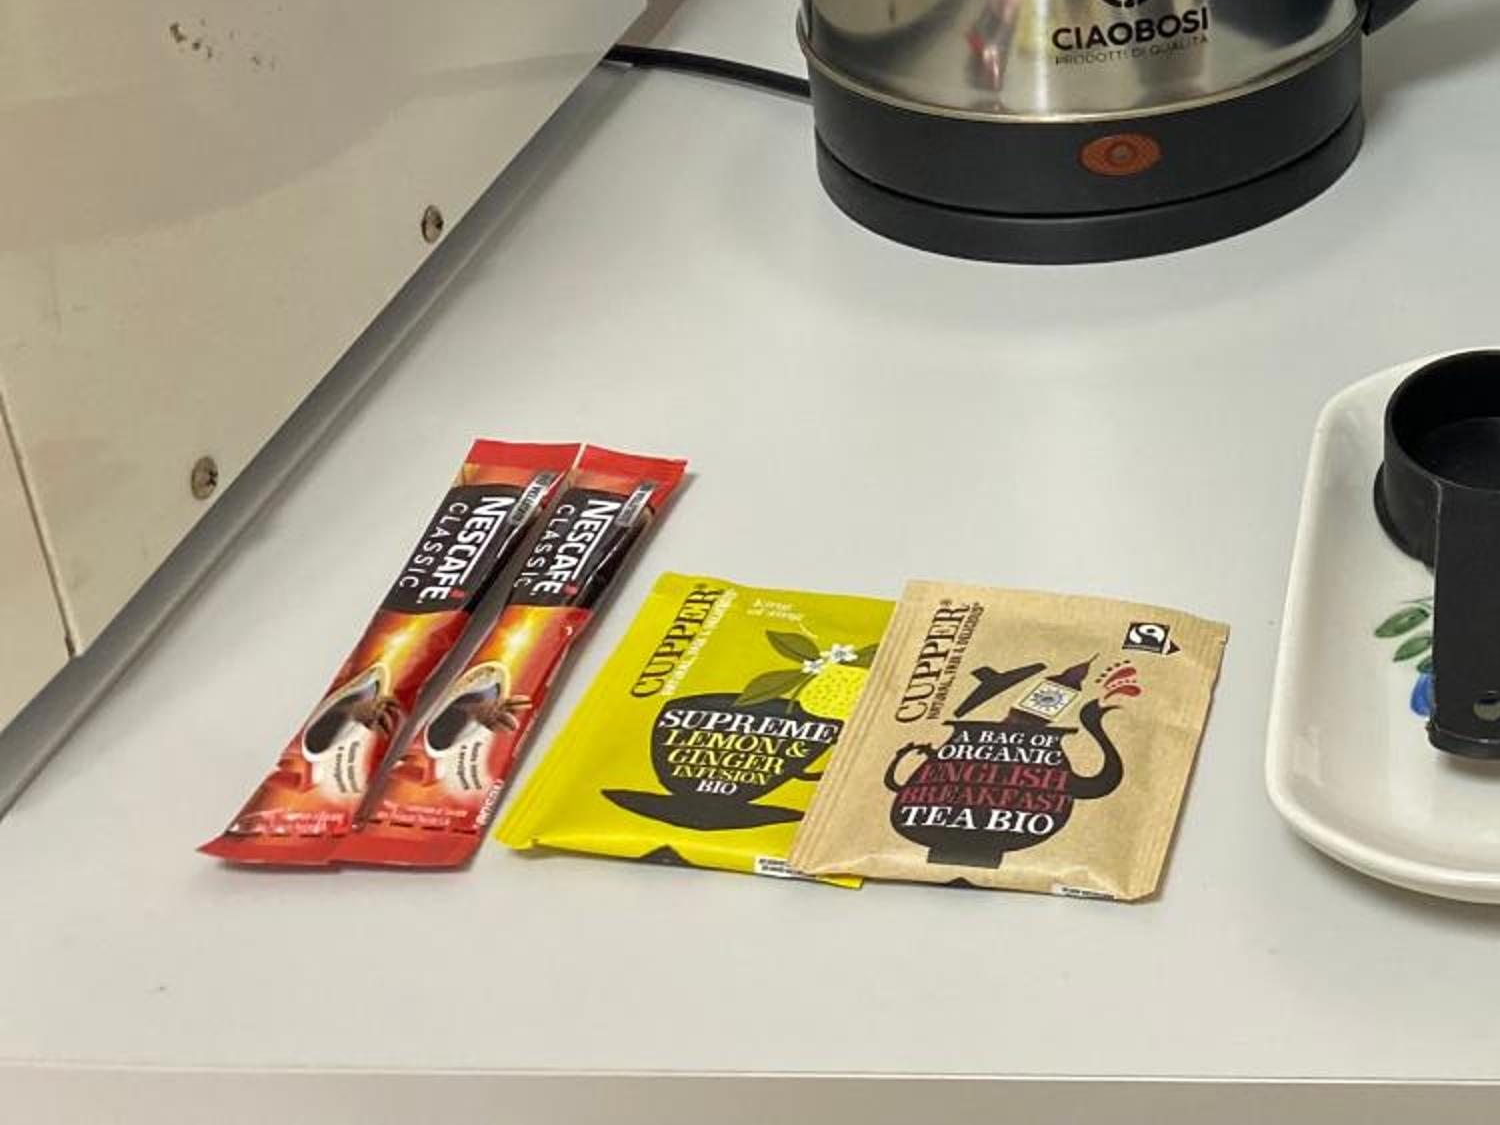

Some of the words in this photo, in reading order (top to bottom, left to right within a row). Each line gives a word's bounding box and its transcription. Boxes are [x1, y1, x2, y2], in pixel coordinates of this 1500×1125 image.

[1052, 7, 1208, 50] CIAOBOSI
[399, 501, 469, 589] CLASSIC
[513, 504, 576, 589] CLASSIC
[658, 709, 838, 745] SUPREME
[954, 730, 970, 744] A
[978, 730, 1024, 744] BAG
[1029, 734, 1059, 747] OF
[664, 729, 787, 756] LEMON
[785, 740, 812, 758] &
[937, 744, 1063, 766] ORGANIC
[667, 747, 785, 774] GINGER
[671, 764, 771, 786] INFUSION
[696, 779, 738, 796] BIO
[917, 761, 1069, 792] ENGLISH
[900, 784, 1075, 813] BREAKFAST
[901, 805, 977, 830] TEA
[984, 808, 1055, 836] BIO
